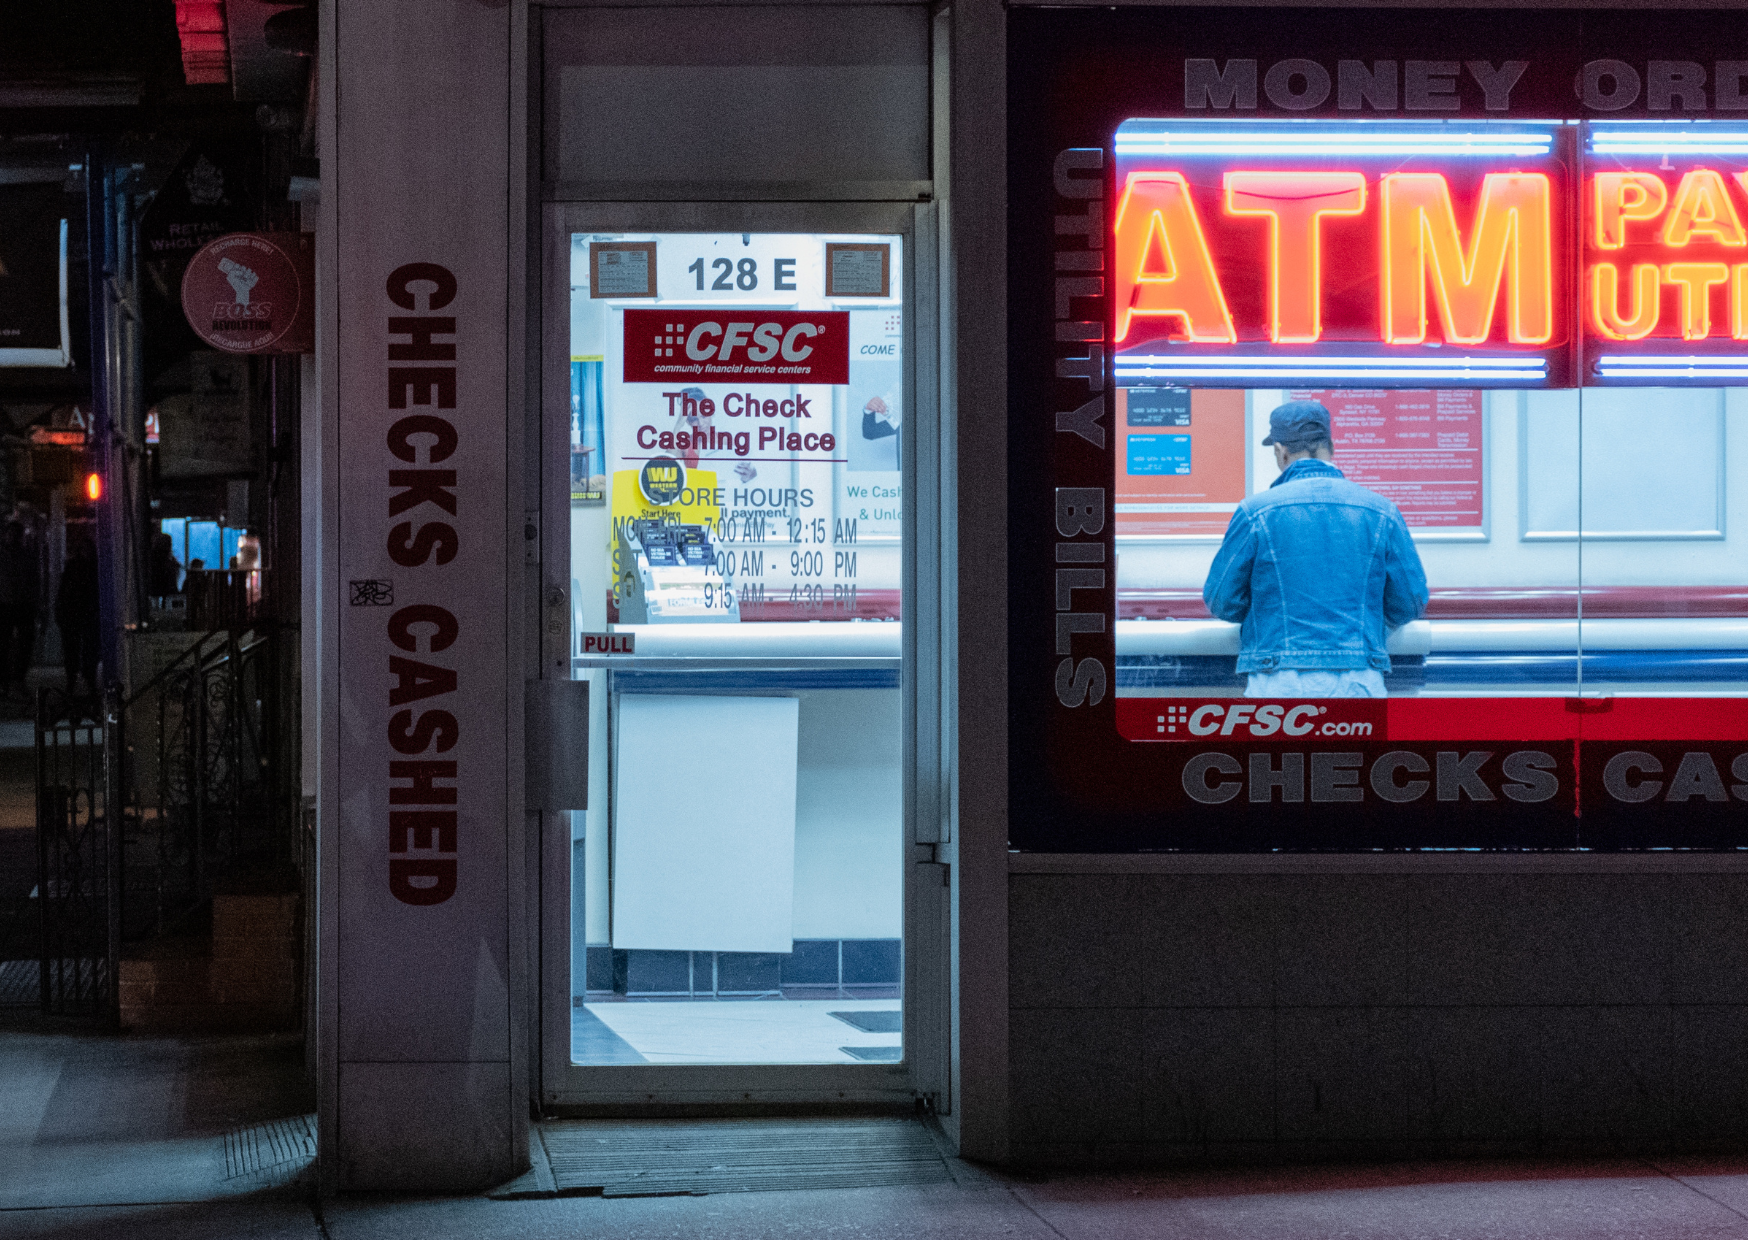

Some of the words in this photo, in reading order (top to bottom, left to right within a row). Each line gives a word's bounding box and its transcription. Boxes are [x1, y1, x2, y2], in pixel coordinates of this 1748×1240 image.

[1184, 58, 1530, 111] MONEY
[1593, 169, 1748, 249] PA
[209, 238, 249, 255] RECHARGE
[1114, 171, 1553, 346] ATM
[688, 257, 758, 291] 128
[774, 258, 797, 291] E
[213, 301, 273, 319] BOSS
[1053, 147, 1106, 449] UTILITY
[212, 320, 272, 331] REVOLUTION
[860, 344, 896, 355] COME
[654, 364, 703, 374] community
[705, 364, 743, 374] financial
[744, 364, 776, 374] service
[777, 365, 811, 374] centers
[386, 262, 459, 567] CHECKS
[662, 392, 715, 418] The
[723, 393, 812, 418] Check
[636, 425, 751, 456] Cashing
[758, 426, 836, 451] Place
[649, 488, 726, 506] STORE
[733, 488, 814, 507] HOURS
[846, 486, 868, 498] We
[641, 509, 659, 518] Start
[661, 509, 682, 518] Here
[859, 508, 869, 520] &
[705, 517, 737, 543] 7:00
[742, 517, 766, 543] AM
[787, 518, 826, 543] 12:15
[834, 518, 857, 543] AM
[704, 550, 736, 576] 7:00
[740, 551, 764, 576] AM
[790, 551, 823, 577] 9:00
[834, 551, 857, 578] PM
[704, 582, 732, 609] 9:15
[741, 583, 765, 609] AM
[789, 583, 824, 610] 4:30
[834, 584, 857, 611] PM
[1054, 487, 1107, 709] BILLS
[585, 636, 632, 653] PULL
[387, 604, 460, 906] CASHED
[1182, 751, 1560, 804] CHECKS
